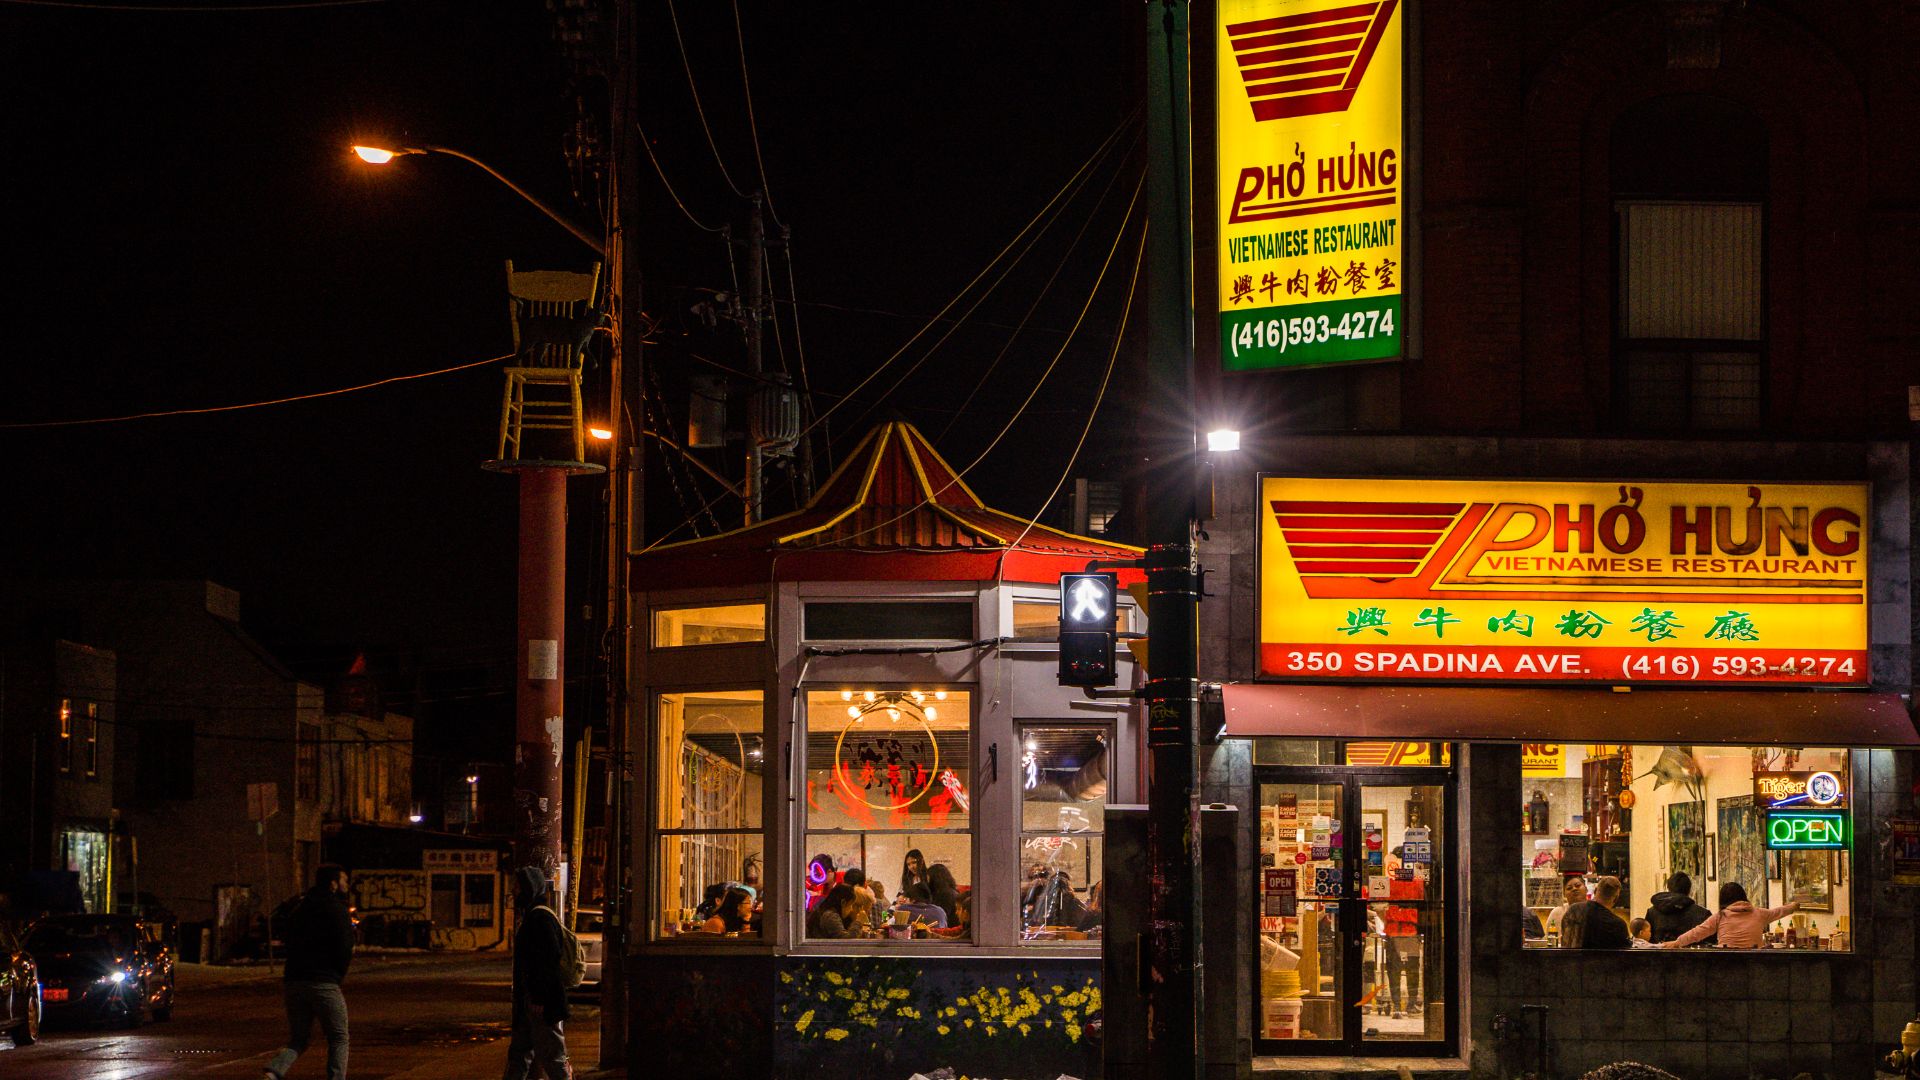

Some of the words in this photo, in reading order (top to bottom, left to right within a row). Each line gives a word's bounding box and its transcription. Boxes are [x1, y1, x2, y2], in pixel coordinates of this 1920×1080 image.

[1229, 229, 1308, 264] VIETNAMESE
[1314, 219, 1396, 255] RESTAURANT
[1231, 308, 1394, 357] (416)593-4274
[1486, 556, 1664, 573] VIETNAMESE
[1672, 557, 1857, 574] RESTAURANT
[1287, 651, 1343, 672] 350
[1354, 652, 1504, 673] SPADINA
[1514, 653, 1591, 675] AVE.
[1623, 654, 1700, 679] (416)
[1712, 656, 1856, 678] 593-4274
[1758, 777, 1806, 800] Tiger
[1772, 819, 1843, 842] OPEN
[1269, 877, 1292, 888] OPEN
